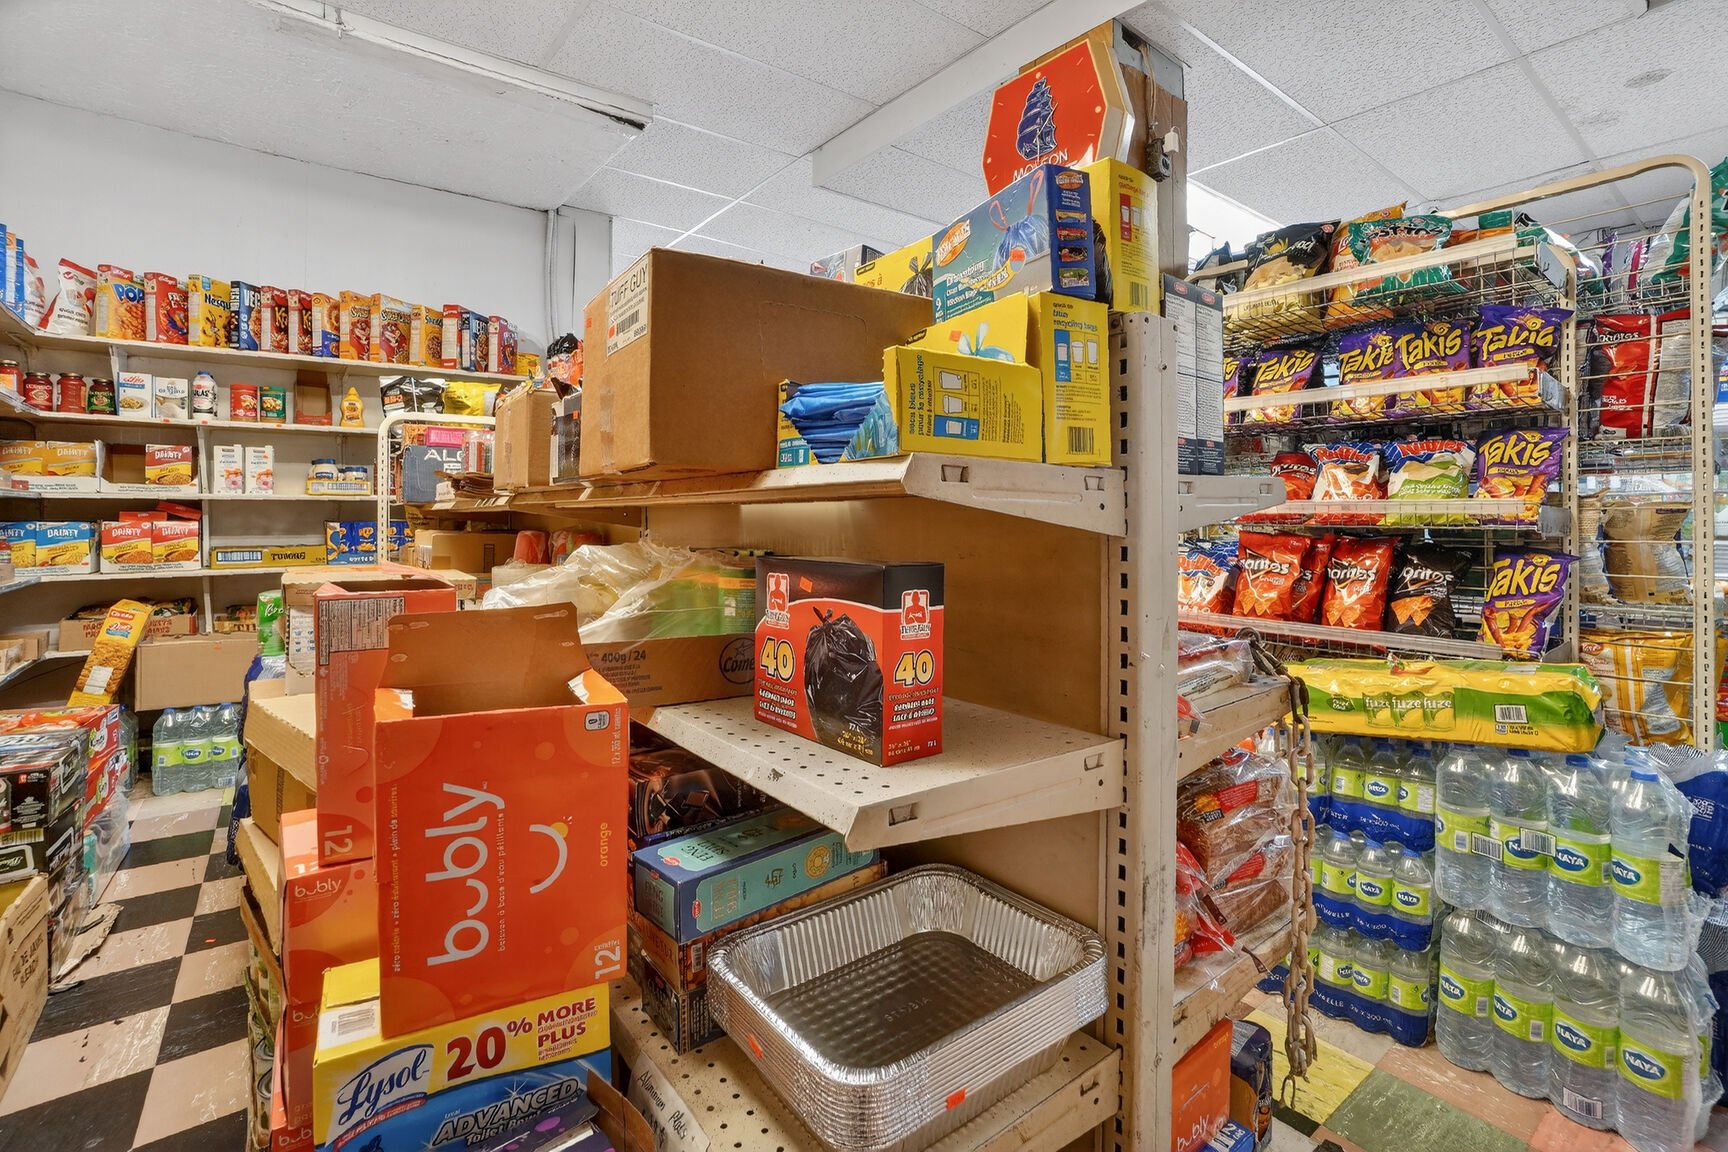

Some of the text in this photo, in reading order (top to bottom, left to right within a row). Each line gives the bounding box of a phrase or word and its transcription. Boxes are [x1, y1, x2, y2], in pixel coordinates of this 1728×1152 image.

[611, 263, 648, 307] TUFF GUY
[1395, 328, 1462, 371] Takis
[1480, 325, 1555, 361] Takis
[1253, 351, 1316, 389] Takis
[1479, 434, 1553, 478] Takis
[47, 526, 79, 538] DAINTY
[112, 528, 142, 538] DAINTY
[1486, 558, 1562, 602] Takis
[601, 651, 627, 664] 400g
[633, 650, 646, 661] 24
[761, 638, 795, 682] 40
[895, 651, 934, 687] 40
[1392, 696, 1422, 710] fuze
[1424, 696, 1452, 709] fuze
[325, 824, 353, 857] 12
[390, 830, 399, 851] plein
[600, 822, 611, 867] orange
[295, 878, 342, 898] bubly
[424, 782, 506, 967] bubly
[595, 946, 621, 980] 12
[538, 997, 596, 1026] MORE
[537, 1021, 587, 1048] PLUS
[1556, 1025, 1587, 1047] NAYA
[1625, 1053, 1660, 1078] NAYA
[337, 1048, 430, 1126] Lysol
[431, 1077, 580, 1147] ADVANCED
